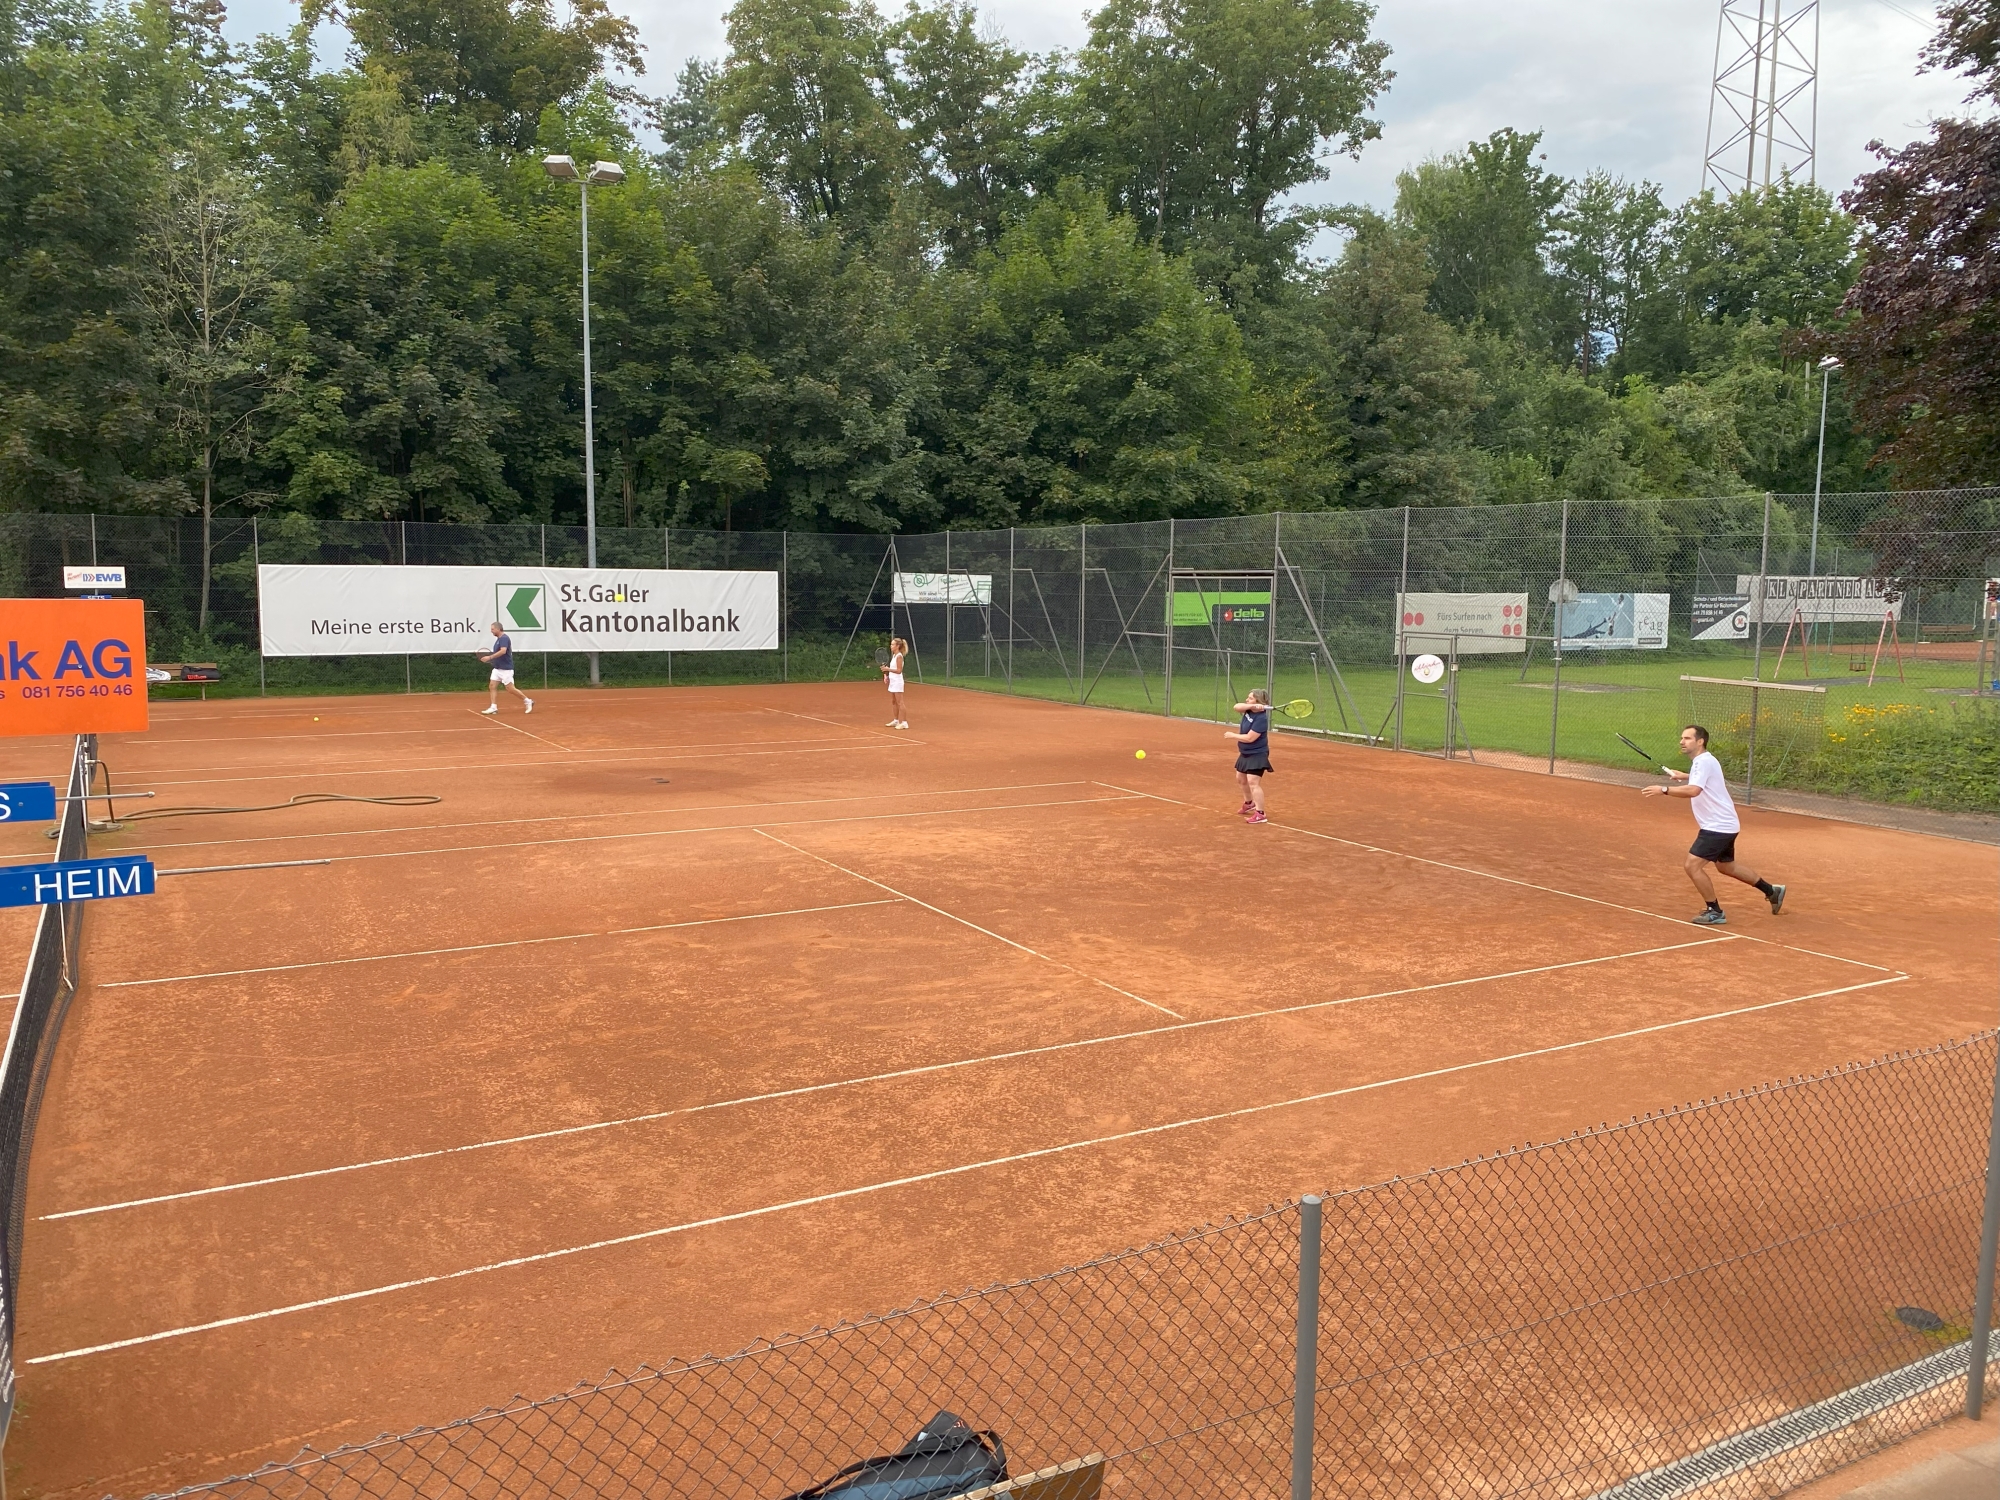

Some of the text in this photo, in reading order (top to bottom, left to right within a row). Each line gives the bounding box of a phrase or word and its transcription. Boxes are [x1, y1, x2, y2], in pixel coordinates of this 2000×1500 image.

[95, 573, 122, 582] EWB
[560, 583, 650, 603] St.Galler
[1799, 581, 1862, 598] PARTNER
[561, 608, 741, 632] Kantonalbank
[1233, 608, 1265, 618] delta
[1437, 611, 1492, 621] Fürs Surfen nach
[310, 617, 482, 635] Meine erste Bank.
[53, 638, 133, 680] AG
[22, 686, 51, 699] 081
[55, 685, 86, 698] 756
[89, 684, 109, 697] 40
[113, 684, 133, 696] 46
[34, 865, 141, 902] HEIM
